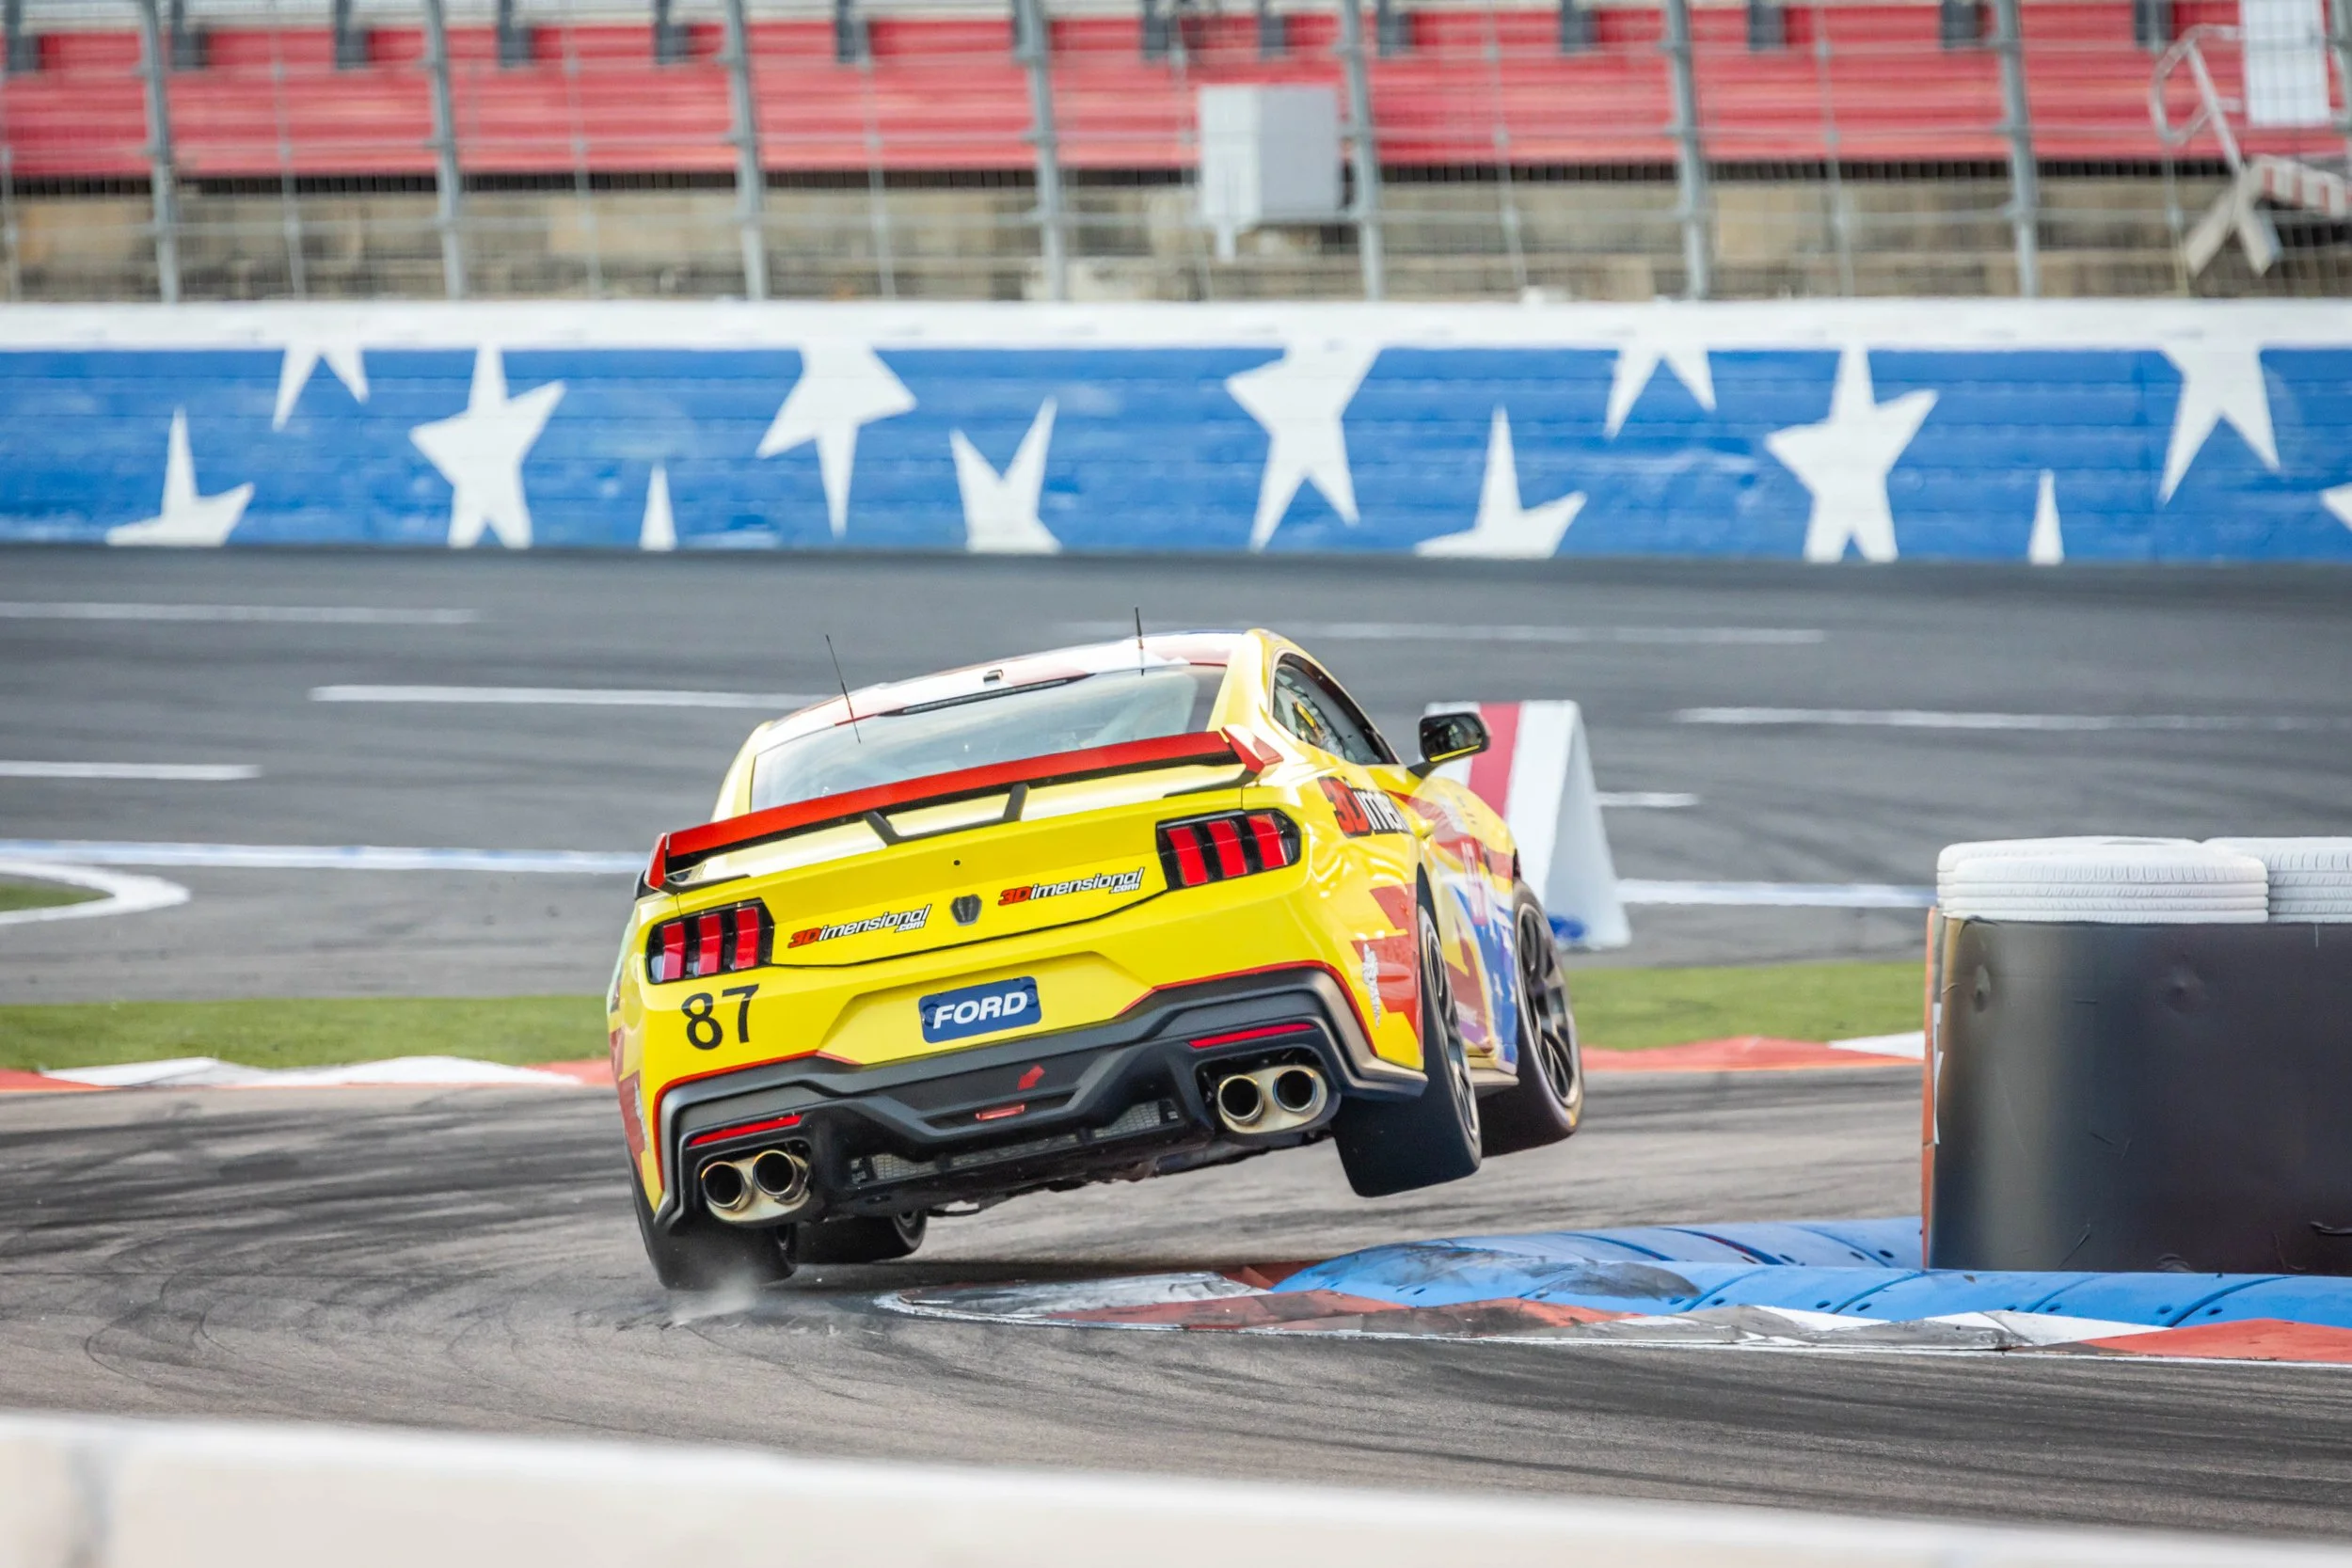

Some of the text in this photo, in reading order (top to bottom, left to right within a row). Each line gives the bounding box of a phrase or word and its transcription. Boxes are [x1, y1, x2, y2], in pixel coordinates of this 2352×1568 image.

[998, 866, 1145, 906] 3Dimensional
[1109, 883, 1140, 895] .com
[787, 904, 932, 948] 3Dimensional
[894, 921, 926, 933] .com
[681, 984, 759, 1050] 87
[933, 991, 1027, 1029] FORD
